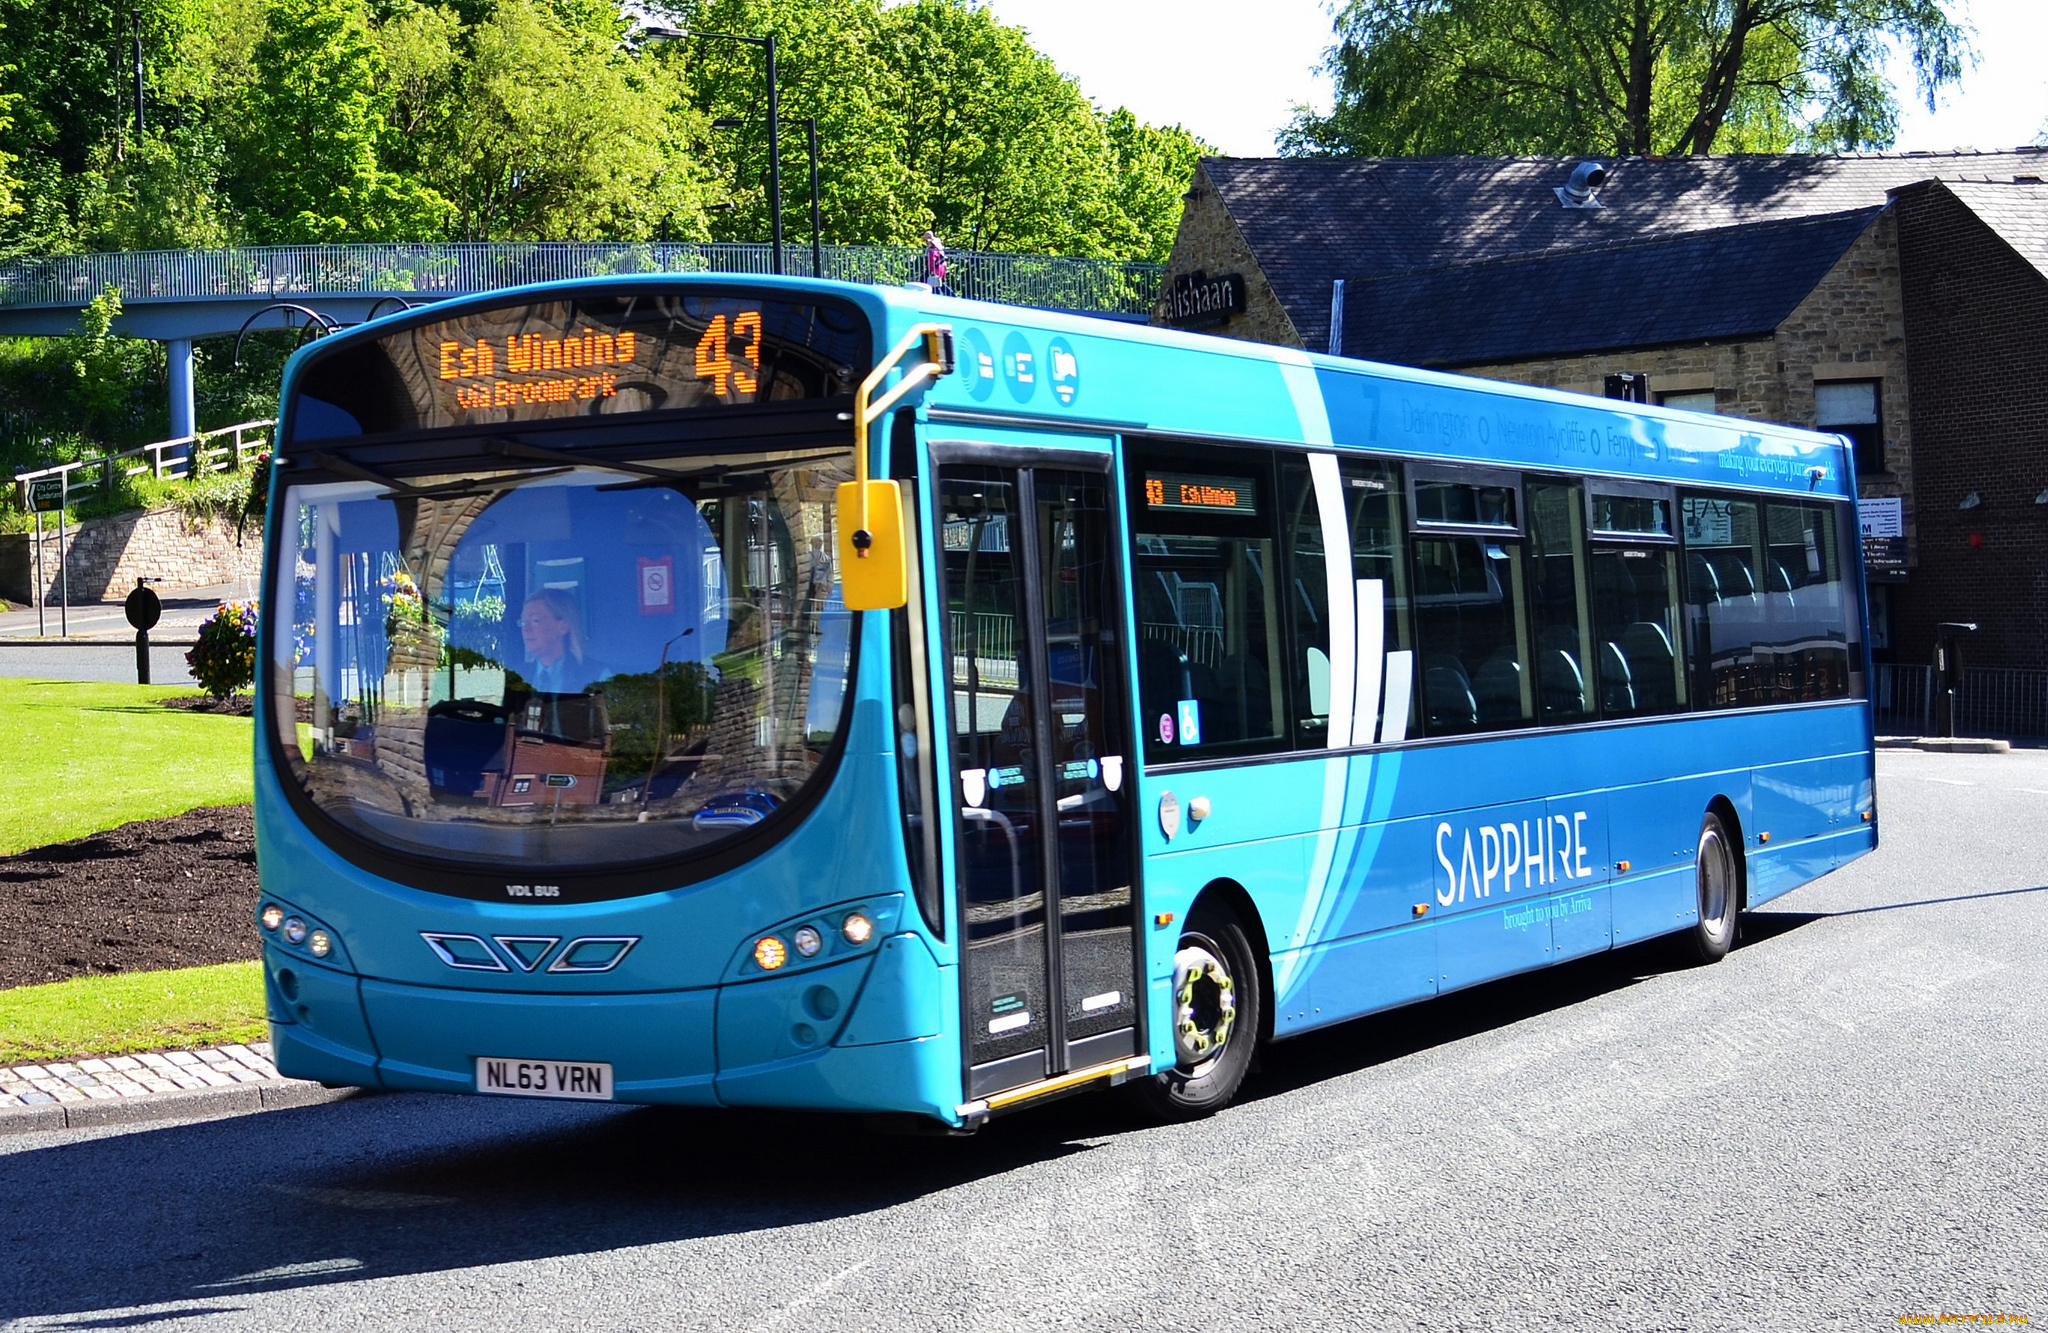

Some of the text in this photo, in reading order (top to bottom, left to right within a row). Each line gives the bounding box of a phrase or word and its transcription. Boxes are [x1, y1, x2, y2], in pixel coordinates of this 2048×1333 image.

[440, 328, 635, 380] Esh Winning
[695, 311, 761, 396] 43
[457, 383, 491, 409] via
[1402, 398, 1471, 446] Darlington
[1547, 419, 1586, 458] Aycliffe
[1718, 449, 1743, 476] making
[1744, 456, 1759, 477] your
[1760, 457, 1788, 481] everyday
[1436, 811, 1592, 907] SAPPHIRE
[506, 885, 560, 897] VDL BUS
[1503, 895, 1592, 932] brought to you by Arriva
[487, 1062, 602, 1093] NL63 VRN
